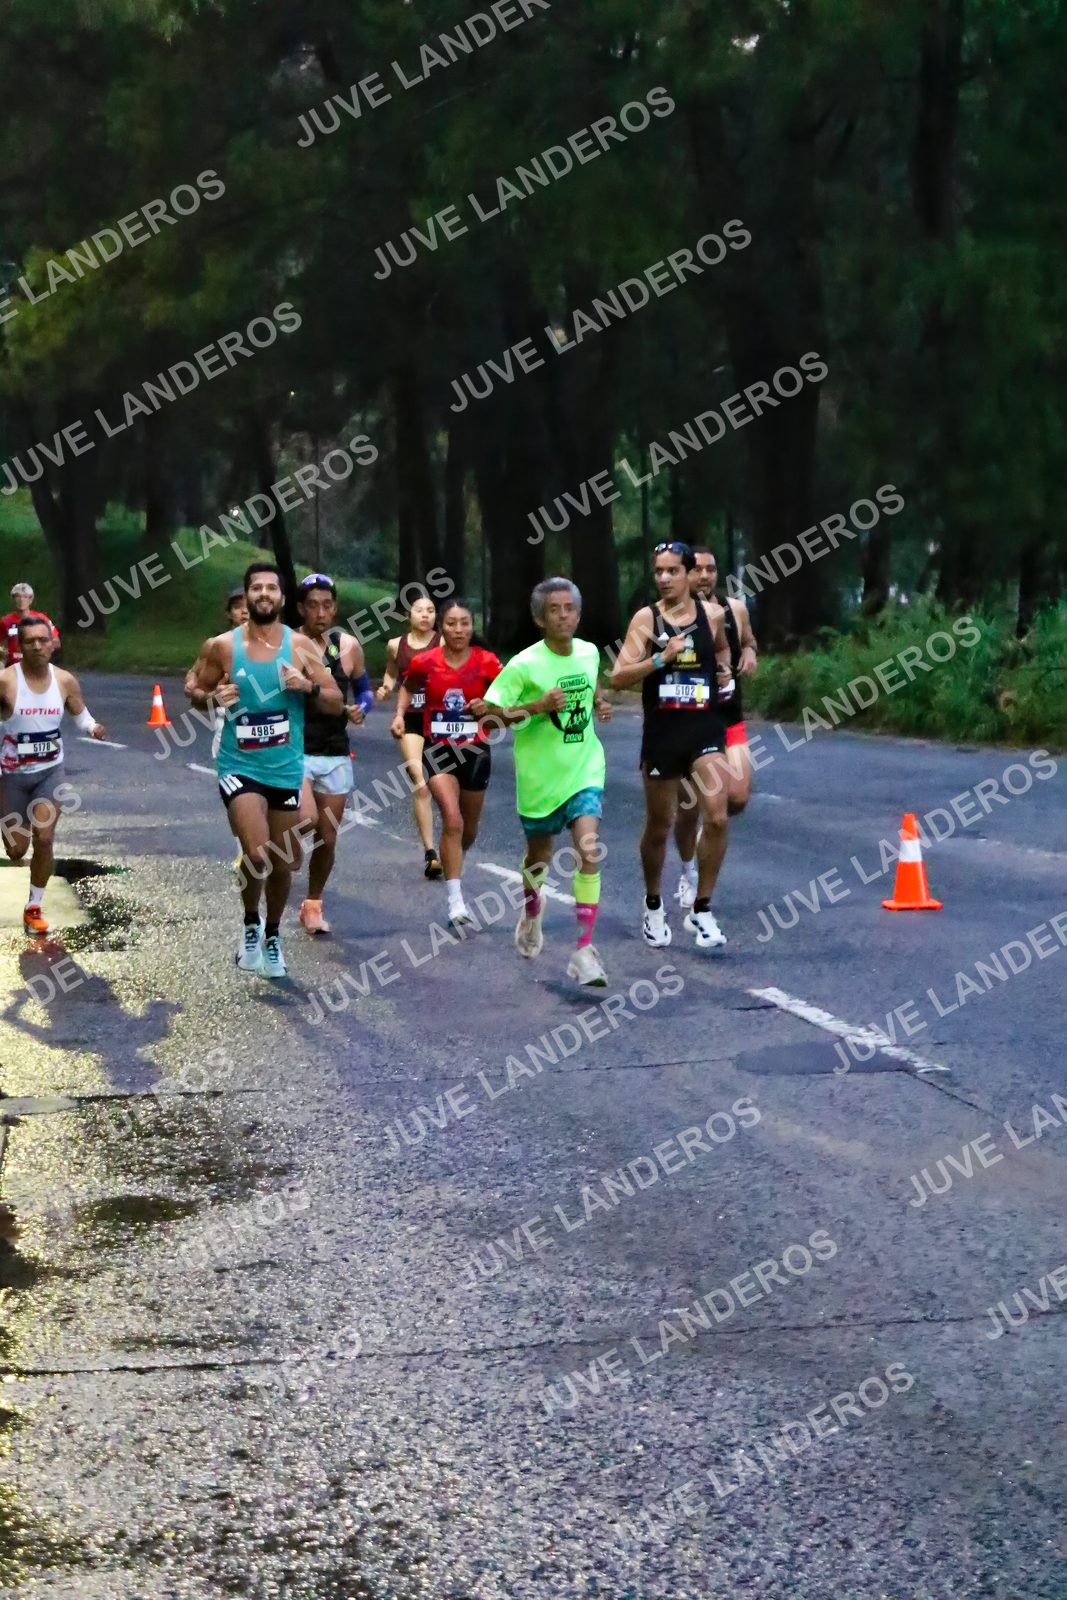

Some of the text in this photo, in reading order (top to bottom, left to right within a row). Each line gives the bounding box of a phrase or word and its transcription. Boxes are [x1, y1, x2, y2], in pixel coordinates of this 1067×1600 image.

[675, 685, 696, 696] 5102
[20, 707, 60, 716] TOPTIME
[250, 724, 275, 737] 4985
[445, 722, 465, 733] 4167
